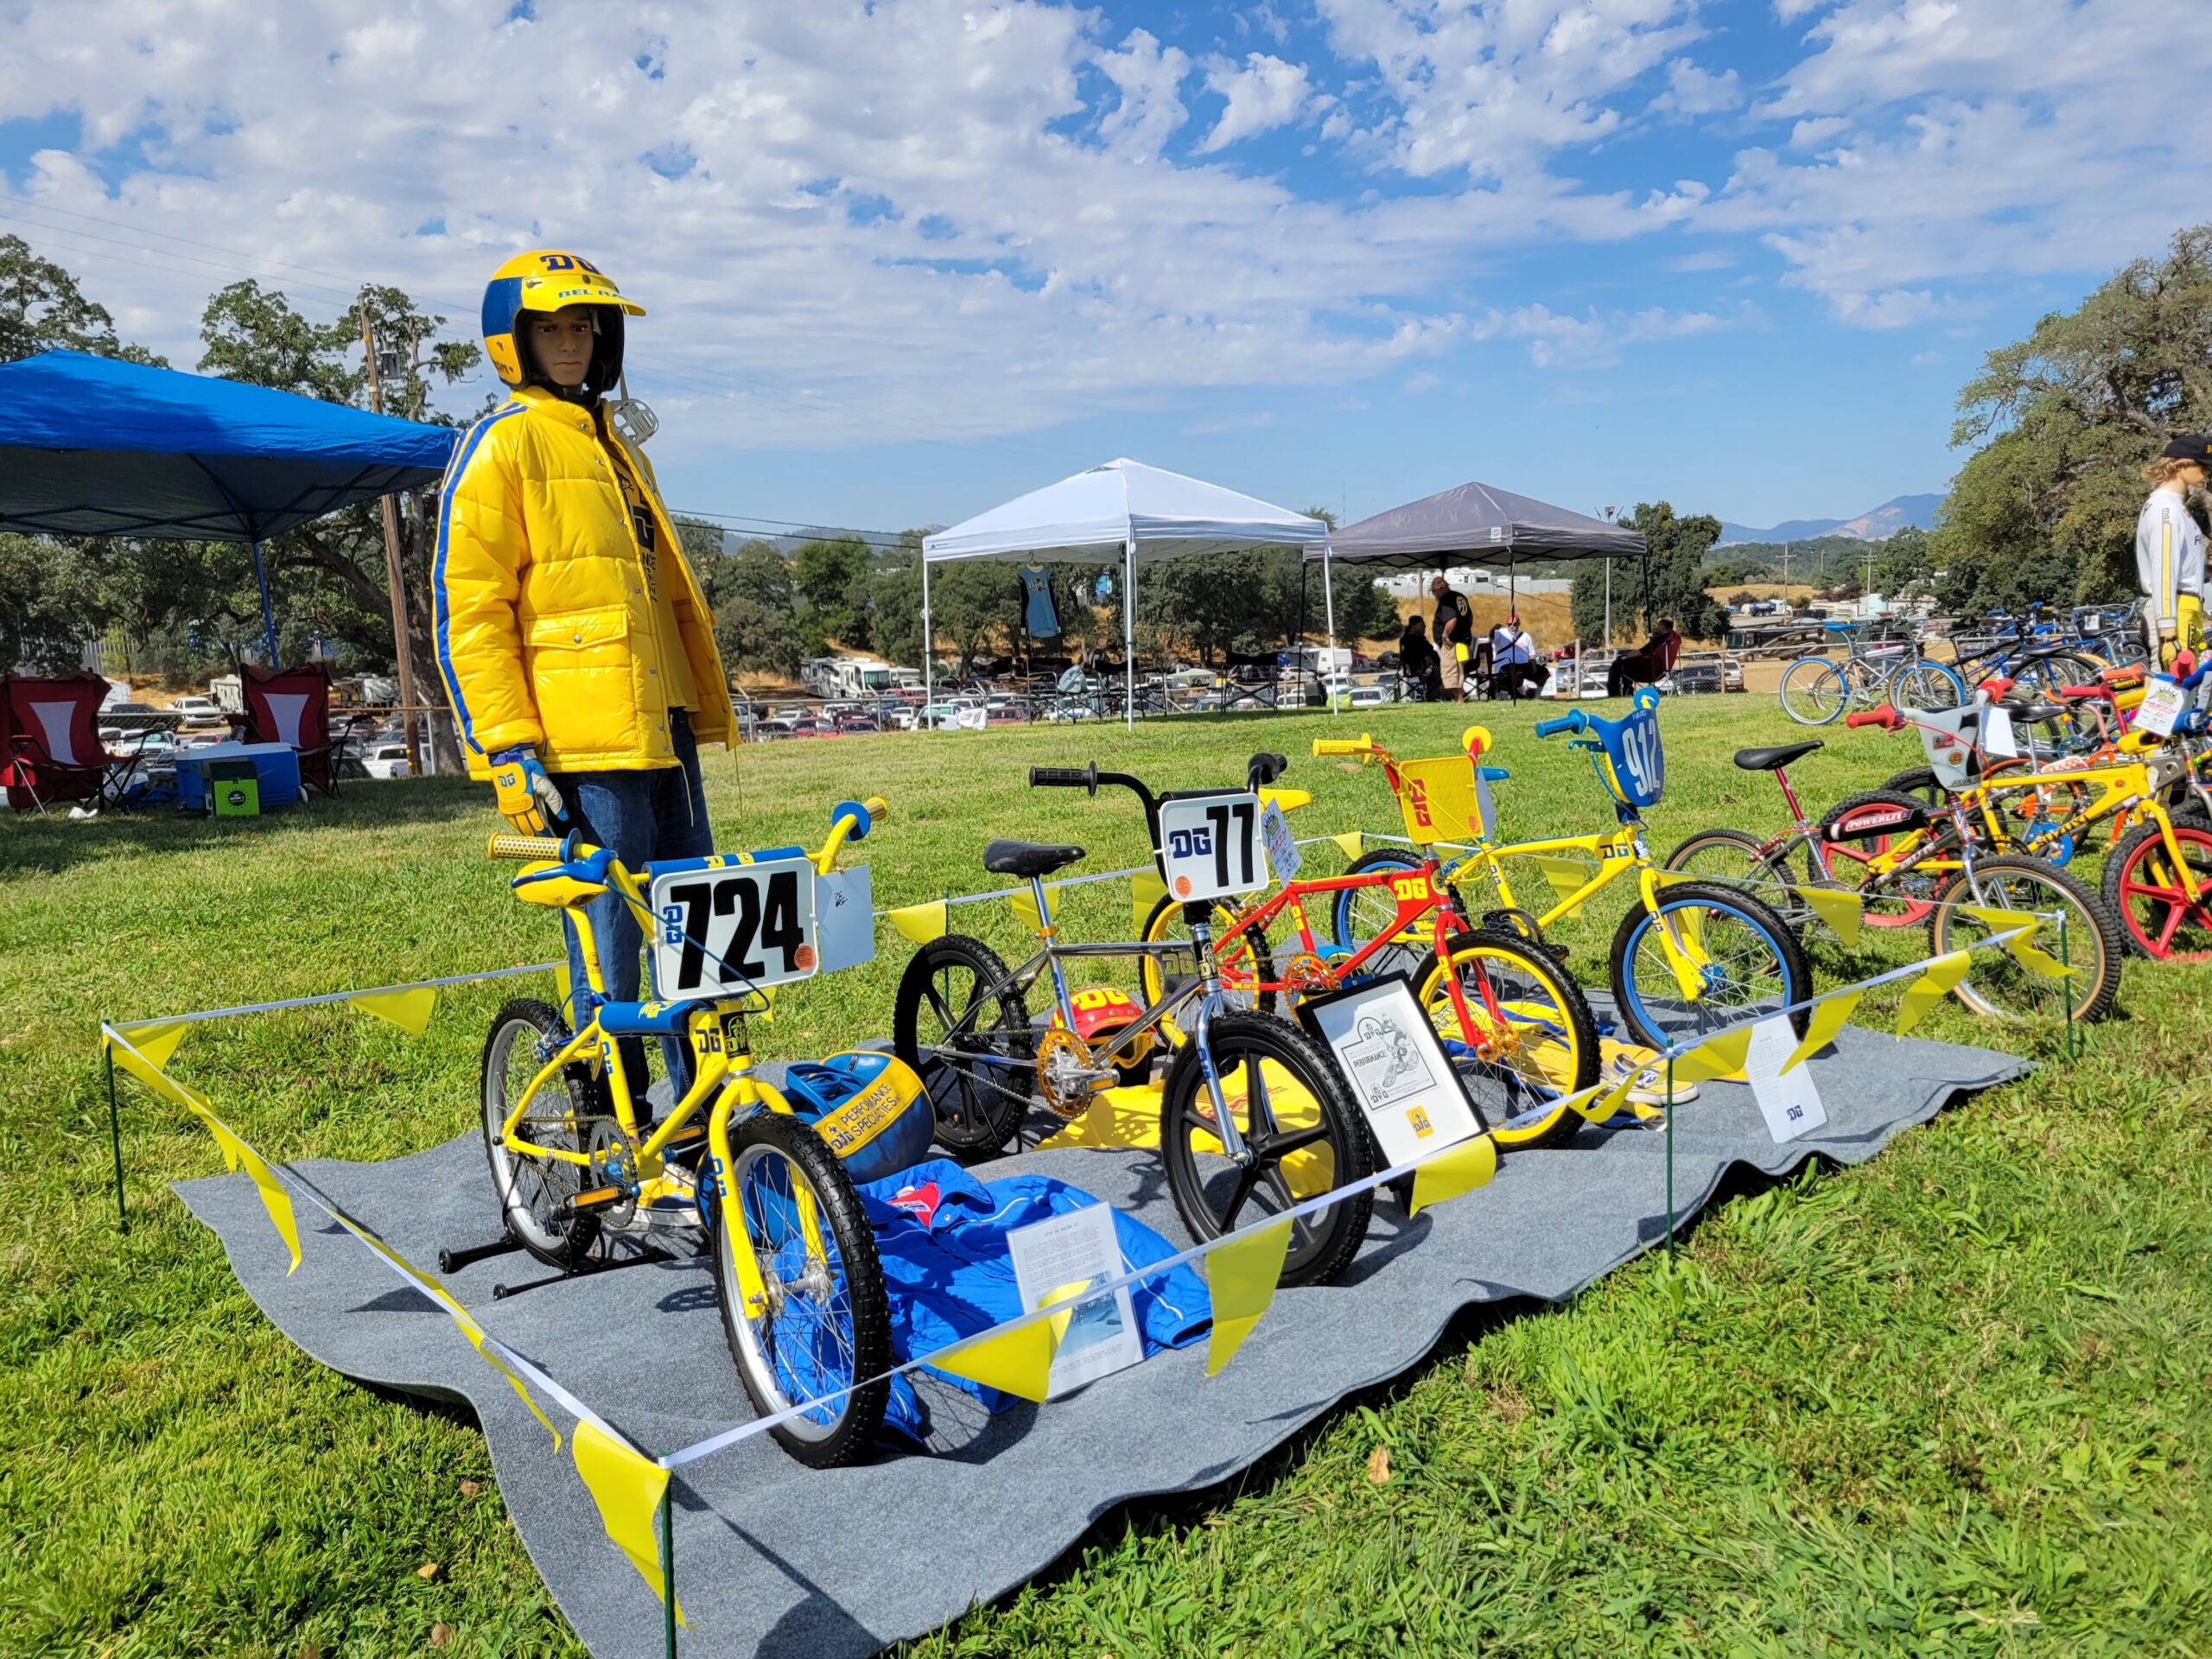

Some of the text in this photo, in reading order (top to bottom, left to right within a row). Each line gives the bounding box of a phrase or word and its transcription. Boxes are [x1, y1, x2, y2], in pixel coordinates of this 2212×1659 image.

[557, 289, 594, 299] BEL
[1621, 718, 1661, 797] 912
[498, 772, 516, 788] DG
[1408, 779, 1433, 827] DG
[1168, 826, 1212, 859] DG
[2036, 814, 2089, 848] SUZUKI
[1599, 843, 1629, 859] DG
[1393, 877, 1428, 901] DG
[663, 904, 683, 944] DG
[670, 870, 804, 990] 724
[1291, 905, 1305, 931] DG
[1649, 910, 1663, 932] DG
[1162, 952, 1196, 976] DG
[1070, 987, 1130, 1011] DG
[694, 1027, 722, 1053] DG
[1352, 1050, 1387, 1068] PERFORMANCE
[840, 1082, 893, 1127] PERFOMANCE
[850, 1096, 898, 1137] SPECIATIES
[1786, 1104, 1803, 1122] DG
